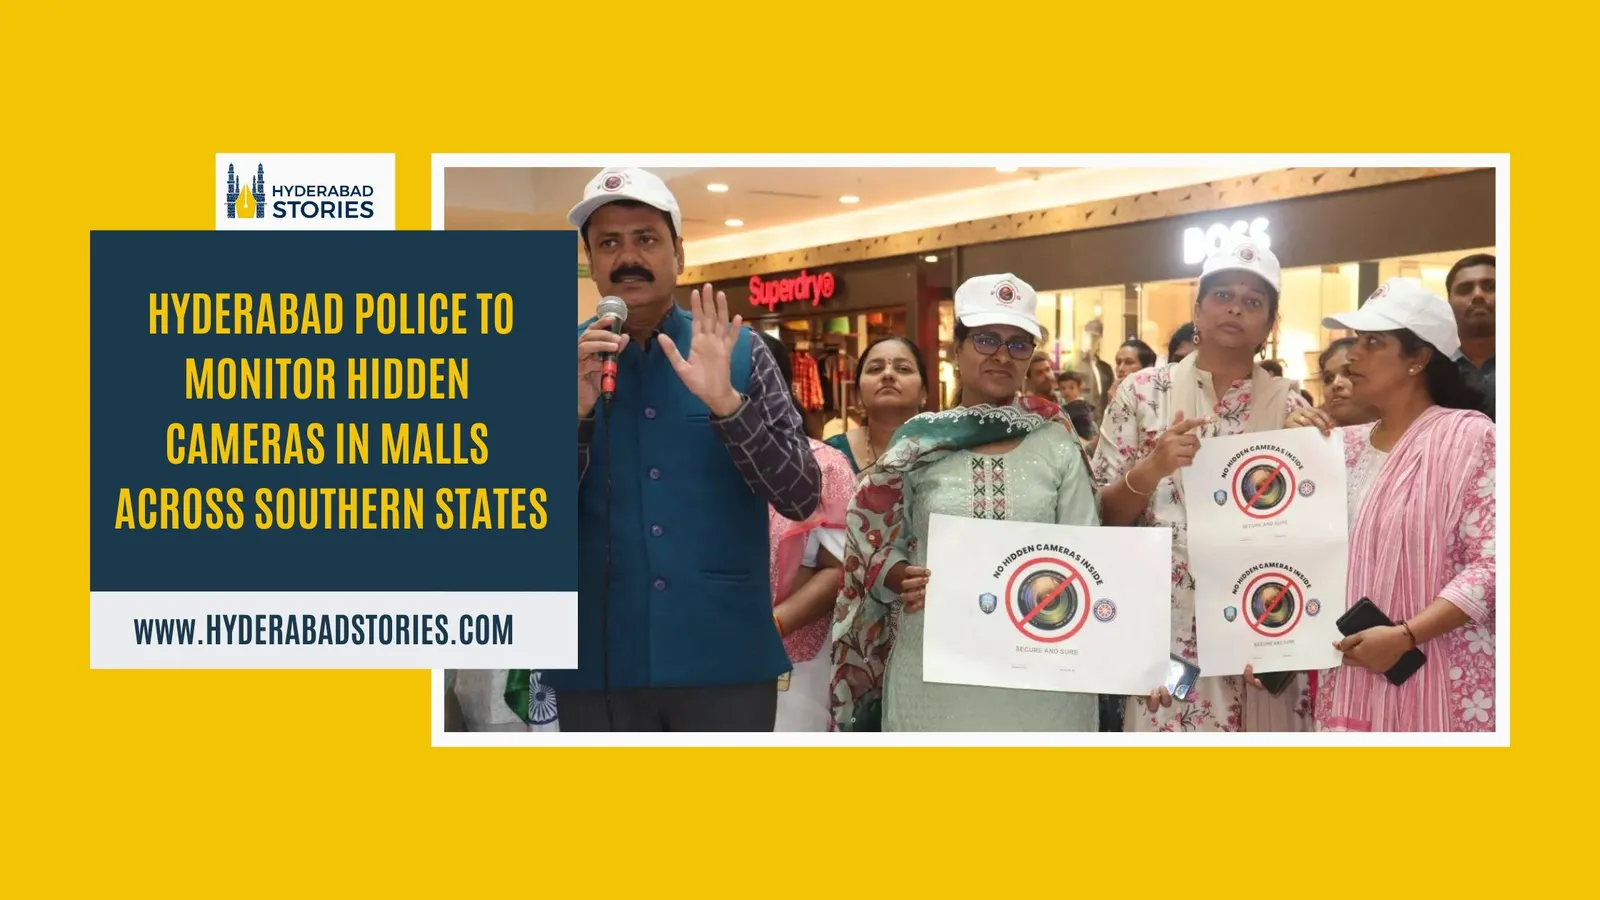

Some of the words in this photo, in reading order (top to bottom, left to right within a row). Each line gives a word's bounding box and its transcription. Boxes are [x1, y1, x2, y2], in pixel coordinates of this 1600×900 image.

[1221, 467, 1229, 478] NO
[1228, 448, 1249, 468] HIDDEN
[1249, 444, 1285, 454] CAMERAS
[1285, 451, 1304, 470] INSIDE
[992, 565, 1004, 579] NO
[1002, 544, 1035, 567] HIDDEN
[1036, 543, 1081, 561] CAMERAS
[1080, 558, 1104, 586] INSIDE
[1231, 584, 1240, 595] NO
[1237, 565, 1259, 585] HIDDEN
[1258, 562, 1293, 572] CAMERAS
[1293, 568, 1312, 589] INSIDE
[1015, 645, 1043, 653] SECURE
[1060, 648, 1079, 656] SURE
